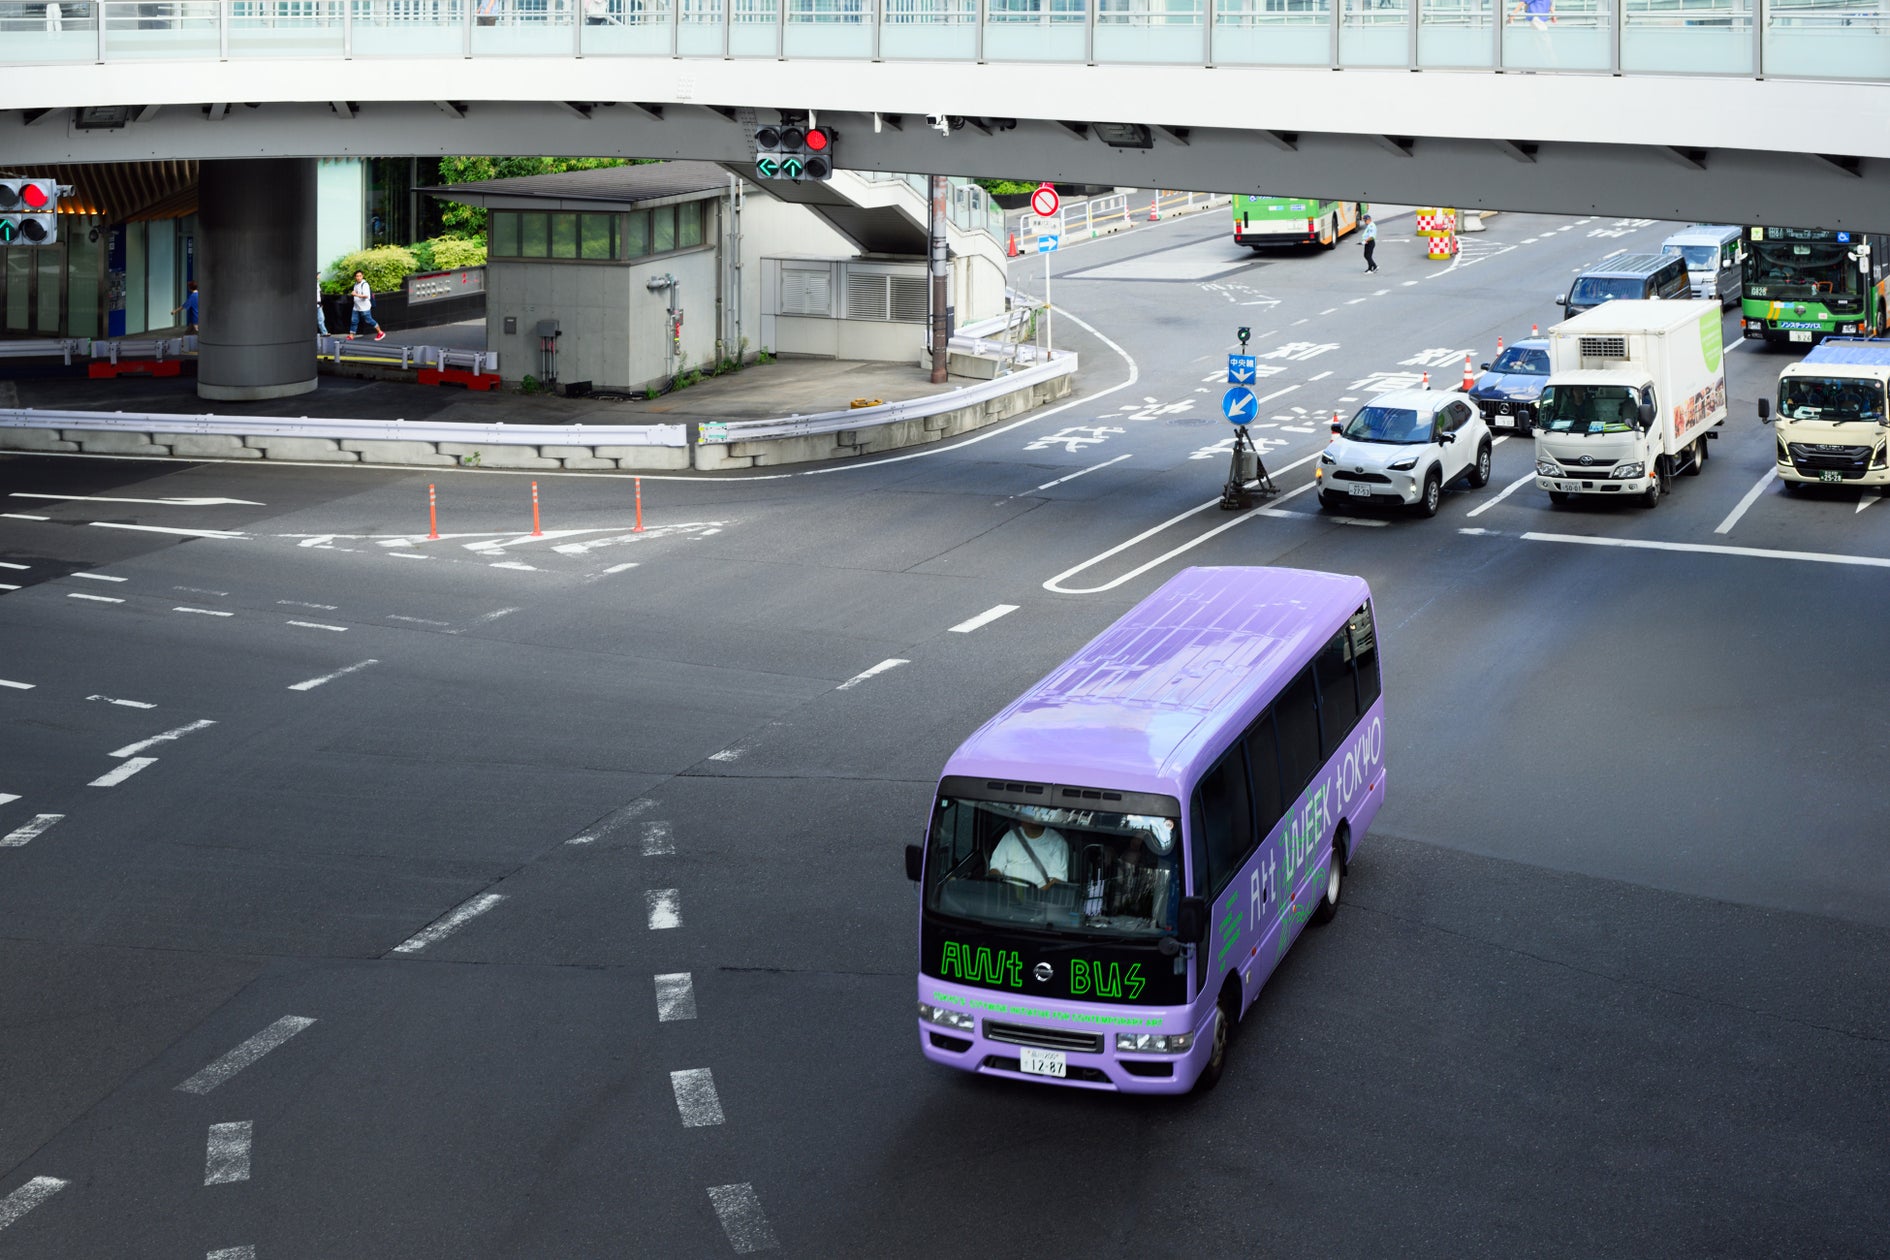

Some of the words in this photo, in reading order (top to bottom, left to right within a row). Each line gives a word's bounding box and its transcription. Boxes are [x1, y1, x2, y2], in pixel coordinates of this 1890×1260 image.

[1781, 320, 1822, 330] ノンステップバス
[1032, 1059, 1064, 1074] 12-87
